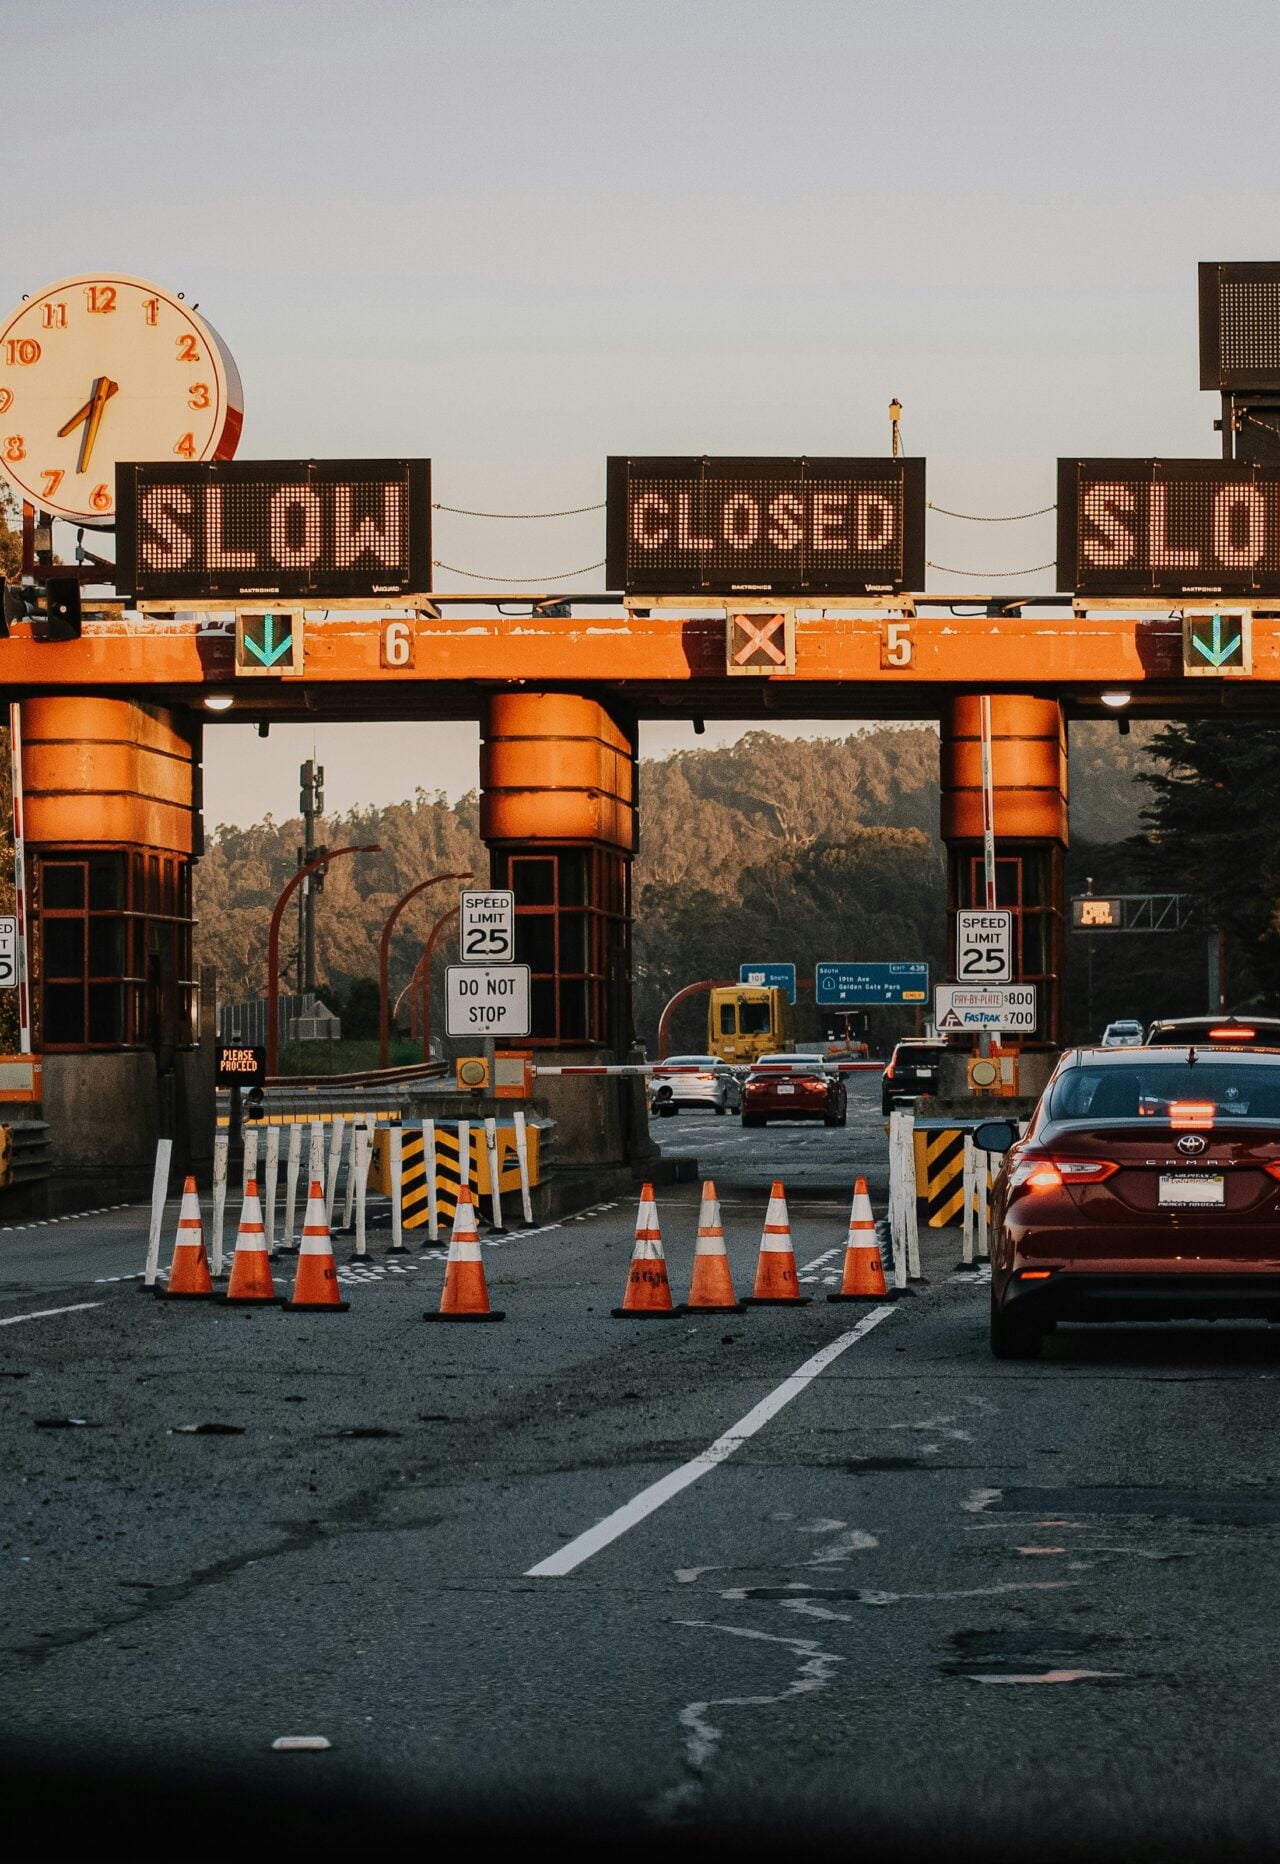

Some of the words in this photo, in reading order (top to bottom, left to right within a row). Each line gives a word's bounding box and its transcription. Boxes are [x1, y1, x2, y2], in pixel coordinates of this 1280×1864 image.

[84, 286, 117, 313] 12
[142, 299, 159, 326] 1
[40, 302, 68, 328] 11
[4, 338, 41, 365] 10
[176, 334, 200, 362] 2
[188, 383, 212, 410] 3
[4, 435, 26, 462] 8
[174, 432, 196, 459] 4
[41, 470, 65, 497] 7
[89, 484, 112, 511] 6
[142, 486, 400, 569] SLOW
[633, 493, 894, 551] CLOSED
[385, 622, 410, 666] 6
[887, 623, 912, 666] 5
[465, 898, 509, 909] SPEED
[469, 913, 505, 923] LIMIT
[962, 918, 1007, 928] SPEED
[466, 928, 509, 955] 25
[966, 933, 1002, 943] LIMIT
[962, 948, 1006, 974] 25
[459, 979, 479, 995] DO
[487, 978, 516, 995] NOT
[954, 994, 1000, 1005] PAY-BY-PLATE
[469, 1006, 507, 1022] STOP
[220, 1060, 258, 1072] PROCEED
[222, 1049, 254, 1061] PLEASE
